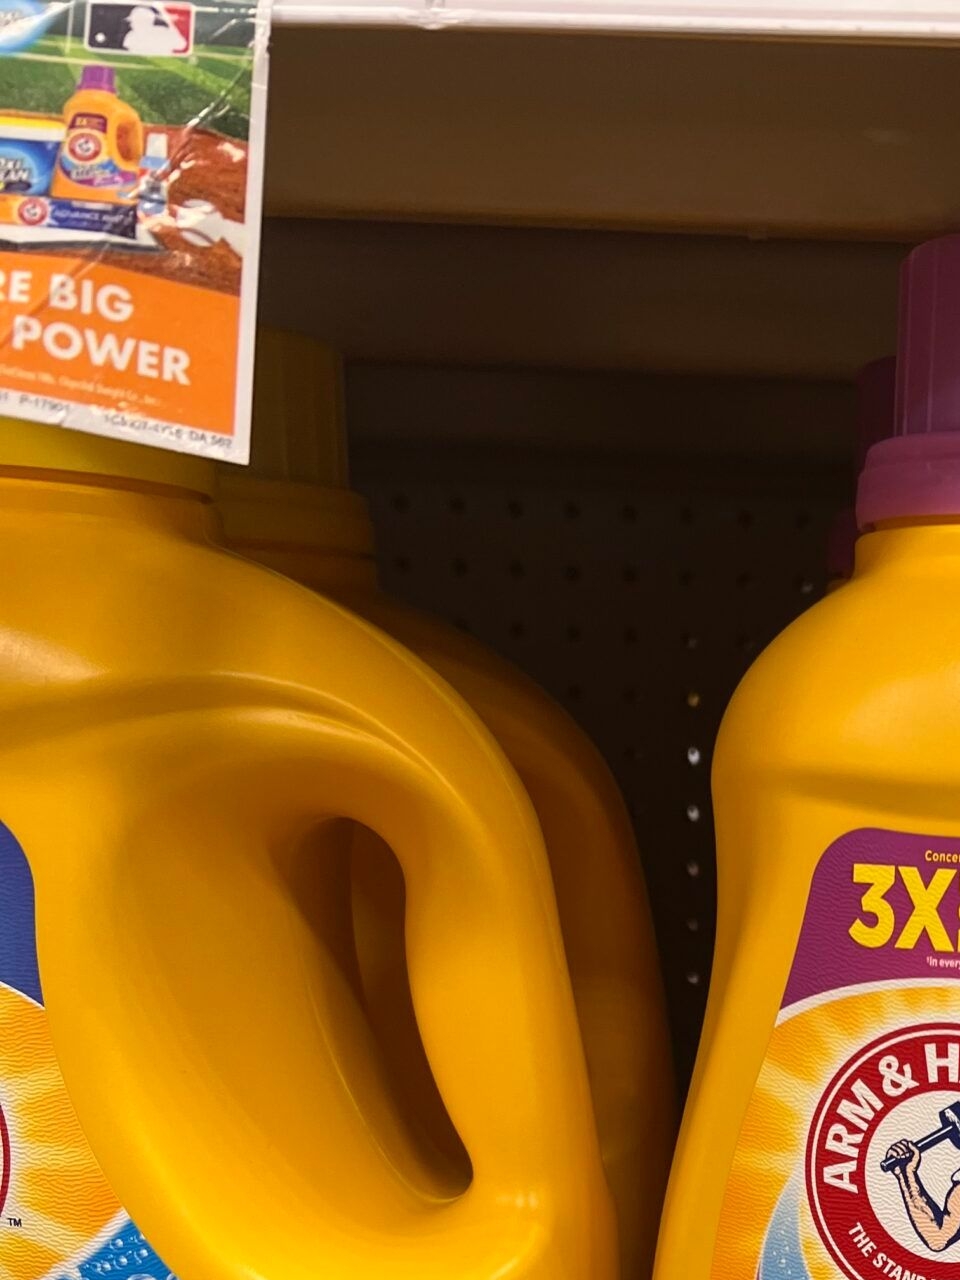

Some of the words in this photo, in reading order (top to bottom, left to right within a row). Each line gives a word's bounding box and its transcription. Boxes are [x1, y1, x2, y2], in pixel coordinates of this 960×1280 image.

[50, 274, 134, 322] BIG
[11, 314, 191, 386] POWER
[848, 864, 957, 952] 3X
[823, 1079, 885, 1194] ARM
[878, 1055, 920, 1097] &
[848, 1222, 875, 1258] THE
